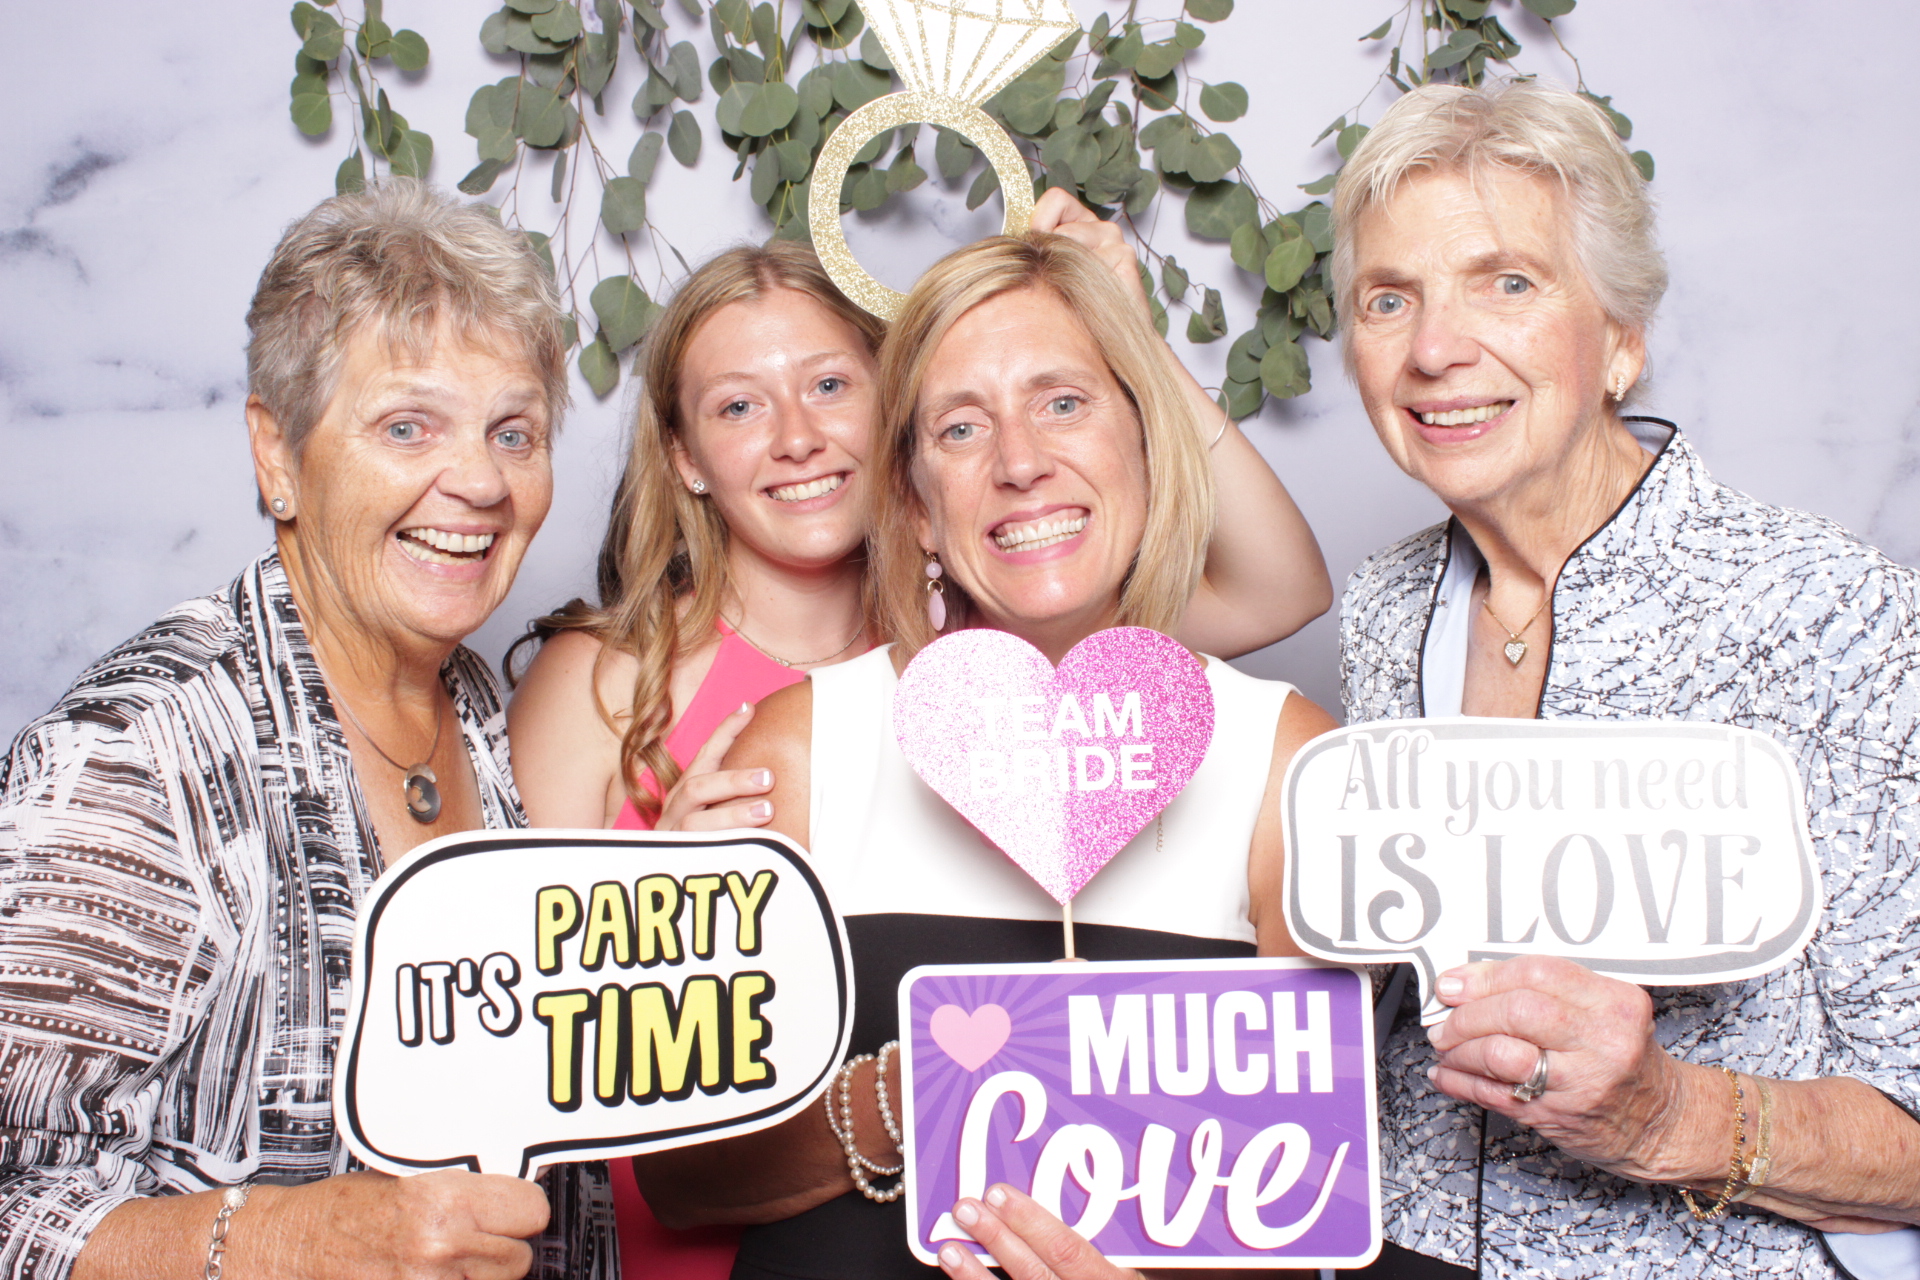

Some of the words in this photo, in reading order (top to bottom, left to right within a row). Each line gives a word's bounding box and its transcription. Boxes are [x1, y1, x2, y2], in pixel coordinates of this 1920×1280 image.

[968, 743, 1157, 795] BRIDE
[971, 691, 1144, 741] TEAM
[1337, 733, 1430, 811] All
[1444, 757, 1566, 836] you
[1590, 733, 1750, 811] need
[535, 869, 779, 977] PARTY
[1336, 832, 1443, 945] IS
[1480, 829, 1763, 946] LOVE
[396, 952, 522, 1048] IT'S
[533, 970, 777, 1113] TIME
[1067, 990, 1334, 1097] MUCH
[926, 1070, 1351, 1251] Love
